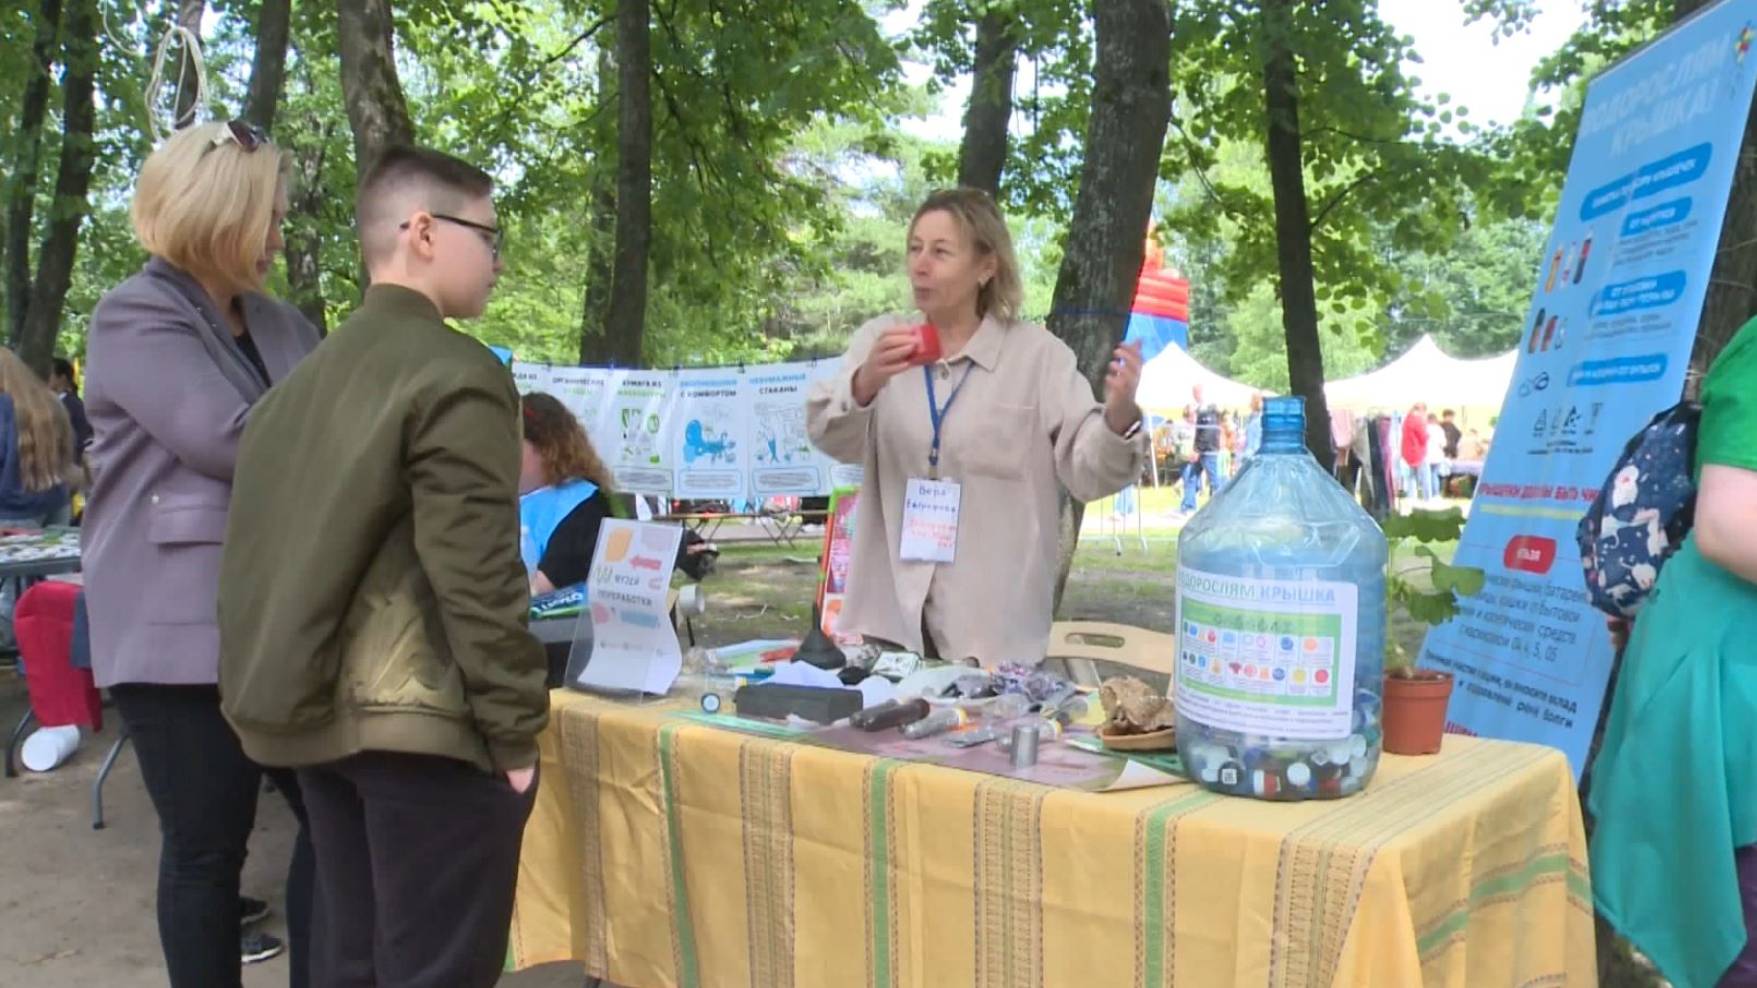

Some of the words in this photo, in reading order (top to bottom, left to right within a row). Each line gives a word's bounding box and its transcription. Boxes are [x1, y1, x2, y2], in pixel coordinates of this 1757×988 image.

[687, 389, 738, 399] КОМФОРТОМ
[758, 385, 798, 396] СТАКАНЫ
[1260, 585, 1336, 602] КРЫШКА
[1548, 693, 1577, 715] вклад
